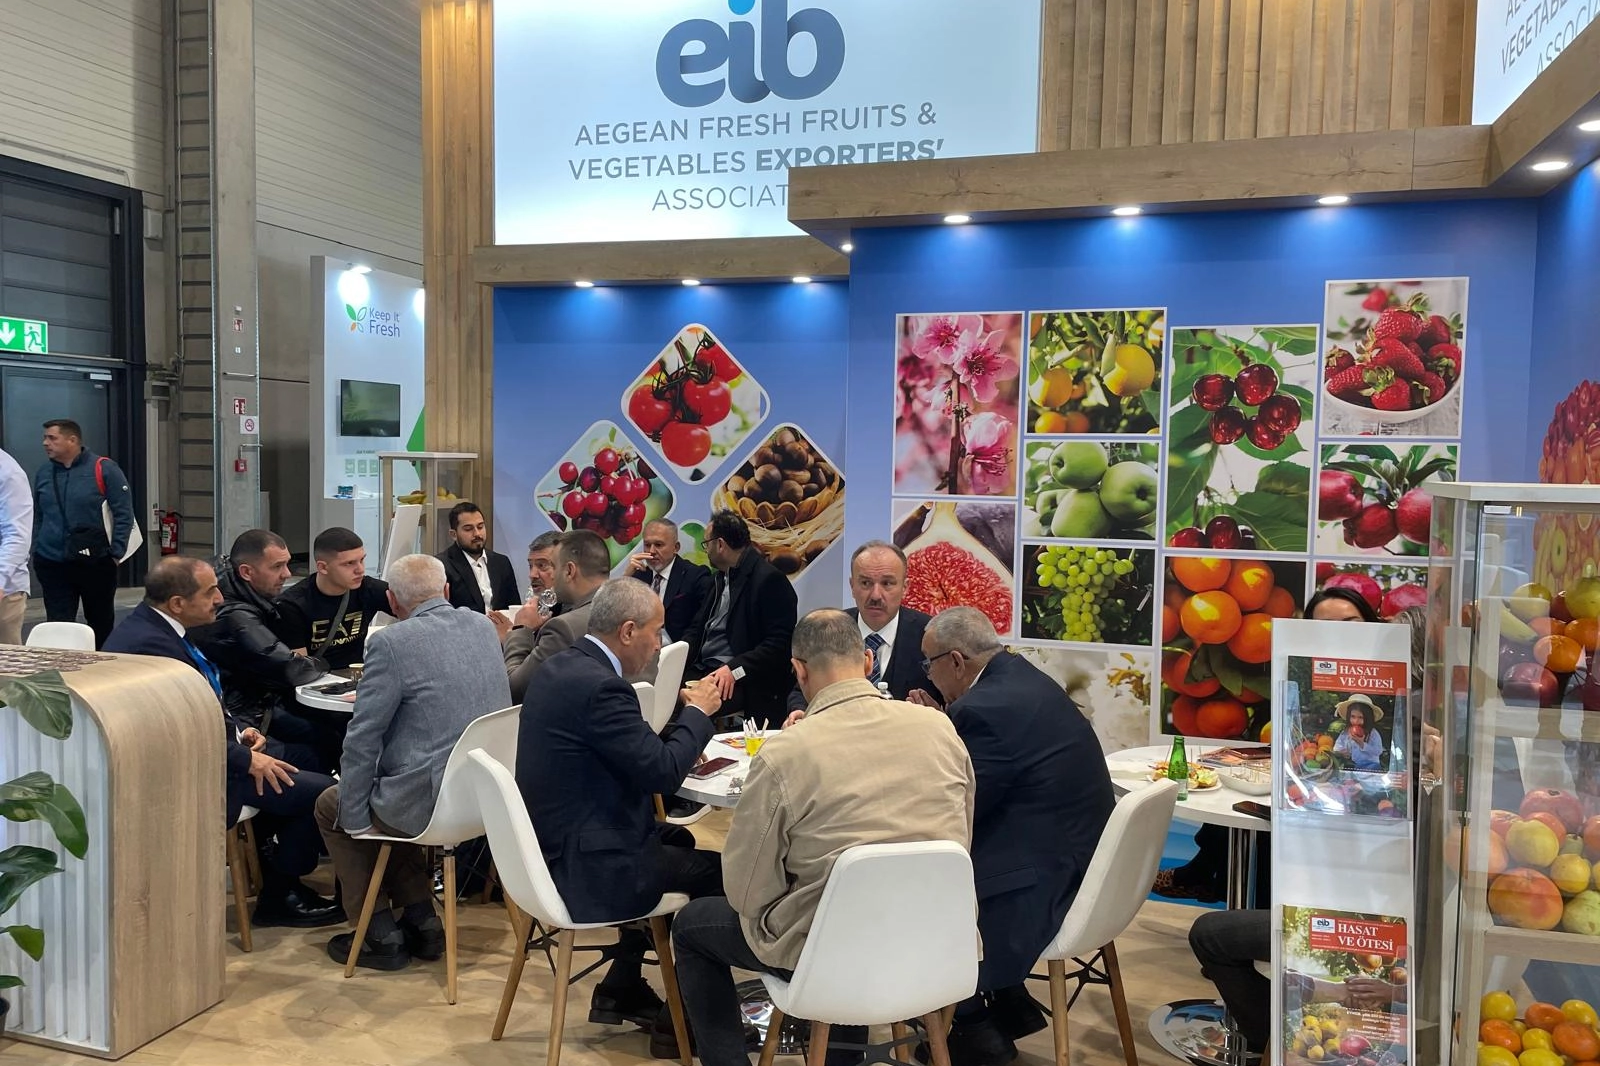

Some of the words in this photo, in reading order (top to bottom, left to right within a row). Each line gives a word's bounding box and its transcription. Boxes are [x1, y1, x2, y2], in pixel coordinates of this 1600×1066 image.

[655, 0, 846, 107] eib
[575, 119, 689, 146] AEGEAN
[699, 112, 790, 139] FRESH
[802, 104, 907, 133] FRUITS
[917, 102, 937, 126] &
[568, 151, 746, 180] VEGETABLES
[652, 184, 788, 212] ASSOCIAT
[370, 307, 391, 323] Keep
[370, 320, 400, 337] Fresh
[1340, 665, 1379, 676] HASAT
[1340, 677, 1356, 687] VE
[1358, 676, 1394, 689] ÖTESİ
[1338, 923, 1379, 937] HASAT
[1338, 936, 1355, 947] VE
[1356, 936, 1394, 951] ÖTESİ
